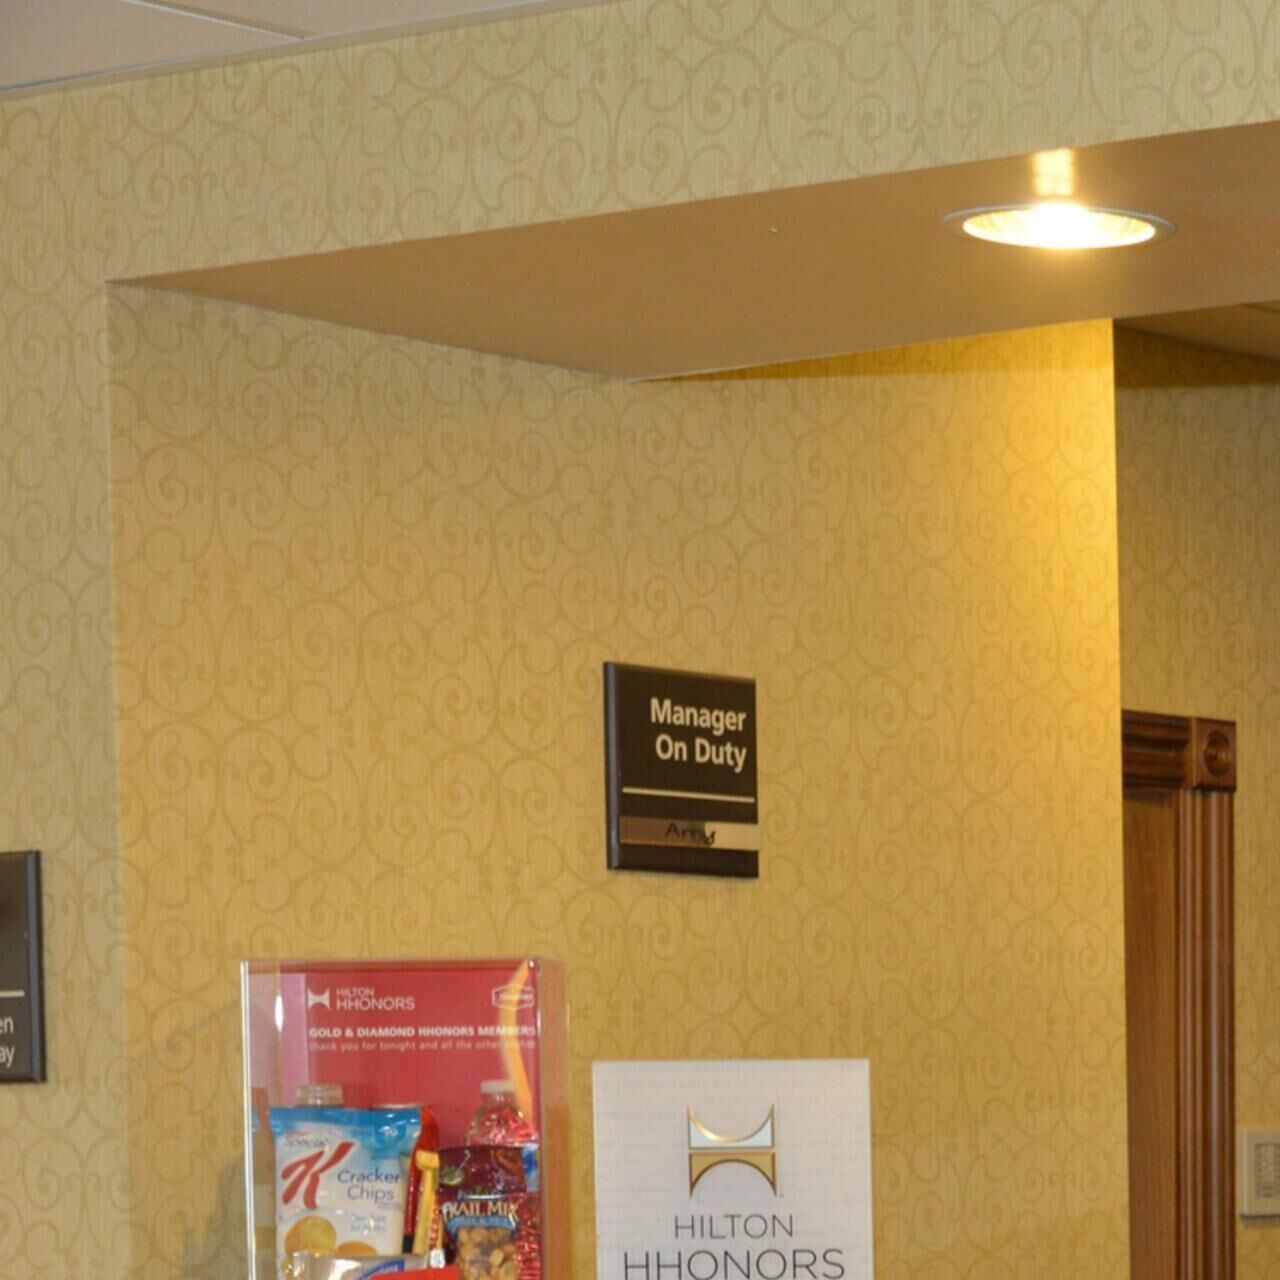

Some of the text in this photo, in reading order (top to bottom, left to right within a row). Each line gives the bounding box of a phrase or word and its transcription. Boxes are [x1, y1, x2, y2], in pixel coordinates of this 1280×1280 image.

[650, 697, 747, 736] Manager
[655, 734, 747, 773] On Duty
[336, 987, 375, 998] HILTON
[336, 997, 415, 1011] HHONORS
[309, 1024, 537, 1038] GOLD & DIAMOND HHONORS MEMBERS
[337, 1168, 401, 1184] Cracker
[346, 1185, 394, 1204] Chips
[674, 1213, 794, 1239] HILTON
